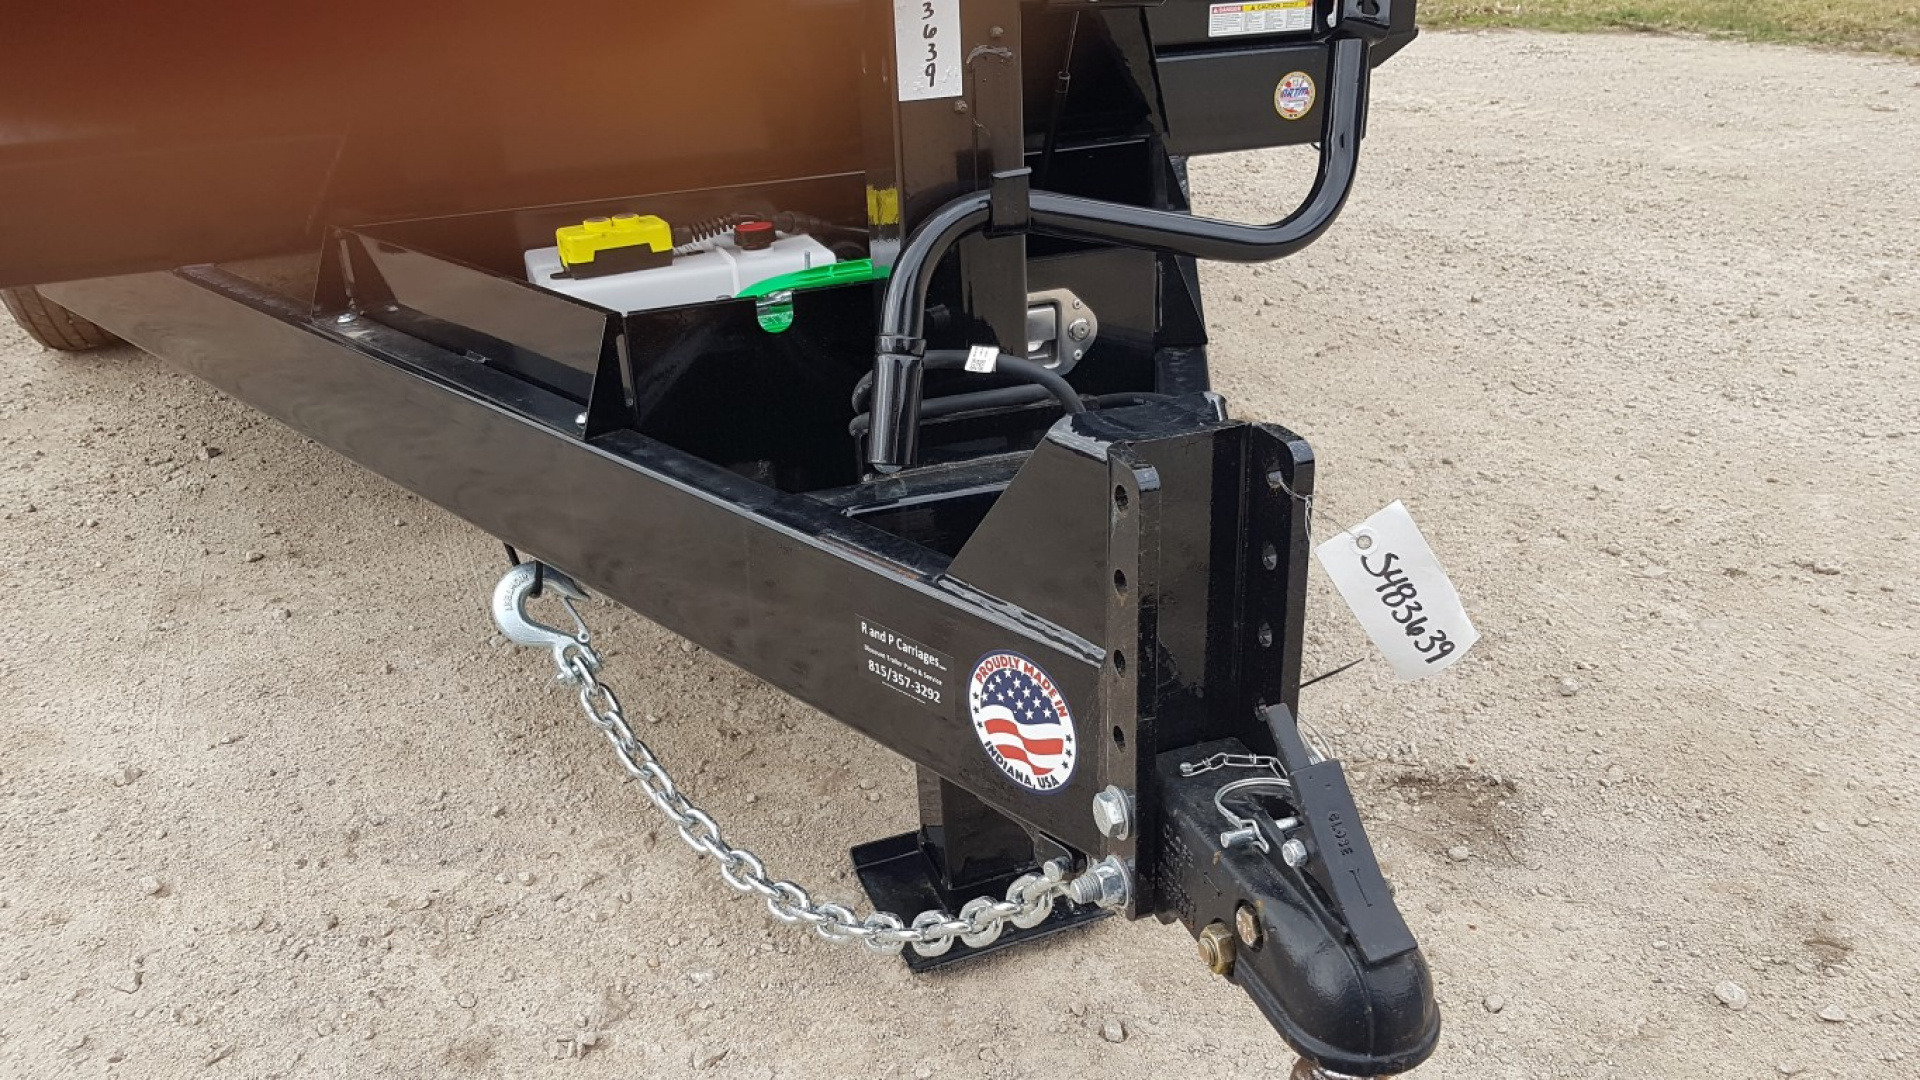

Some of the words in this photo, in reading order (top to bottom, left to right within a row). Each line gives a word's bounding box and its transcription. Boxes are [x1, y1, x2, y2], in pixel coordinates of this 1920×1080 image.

[861, 621, 868, 634] R
[868, 628, 886, 643] and
[888, 633, 895, 646] P
[895, 638, 939, 667] Carriages
[868, 659, 942, 704] 815/357-3292
[903, 662, 918, 675] Parts
[918, 668, 924, 677] &
[923, 671, 943, 686] Service
[975, 655, 1020, 684] PROUDLY
[1023, 662, 1058, 698] MADE
[1054, 699, 1068, 718] IN
[984, 740, 1036, 790] INDIANA,
[1036, 774, 1060, 790] USA
